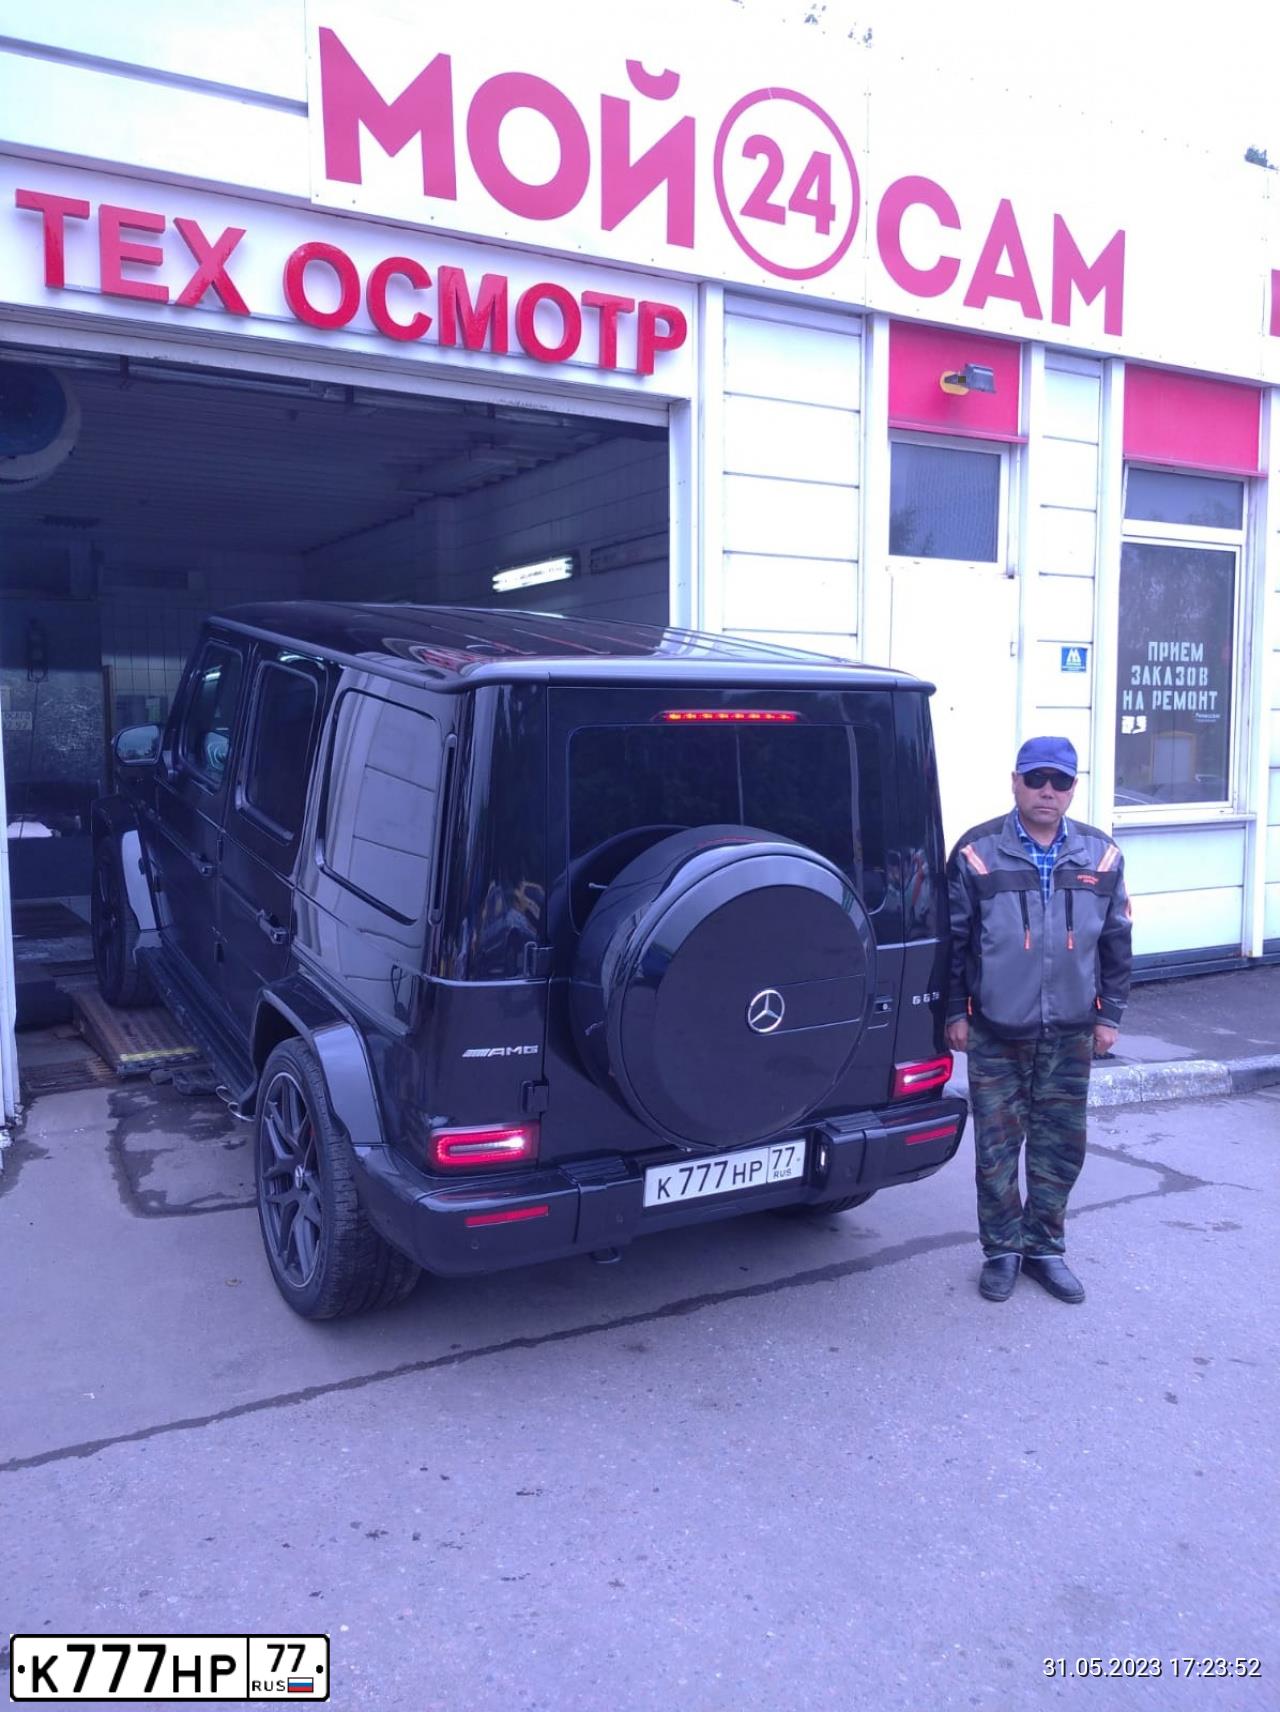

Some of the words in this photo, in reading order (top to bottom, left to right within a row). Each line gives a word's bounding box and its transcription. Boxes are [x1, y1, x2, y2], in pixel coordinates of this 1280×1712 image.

[318, 26, 696, 249] МОЙ
[740, 134, 836, 235] 24
[877, 175, 1126, 337] САМ
[15, 189, 250, 315] ТЕХ
[283, 242, 688, 376] ОСМОТР
[1148, 641, 1204, 662] ПРИЕМ
[1131, 665, 1208, 686] ЗАКАЗОВ
[1123, 690, 1144, 711] НА
[1152, 690, 1218, 711] РЕМОНТ
[488, 1045, 539, 1057] AMG
[771, 1146, 796, 1170] 77
[773, 1168, 792, 1179] RUS
